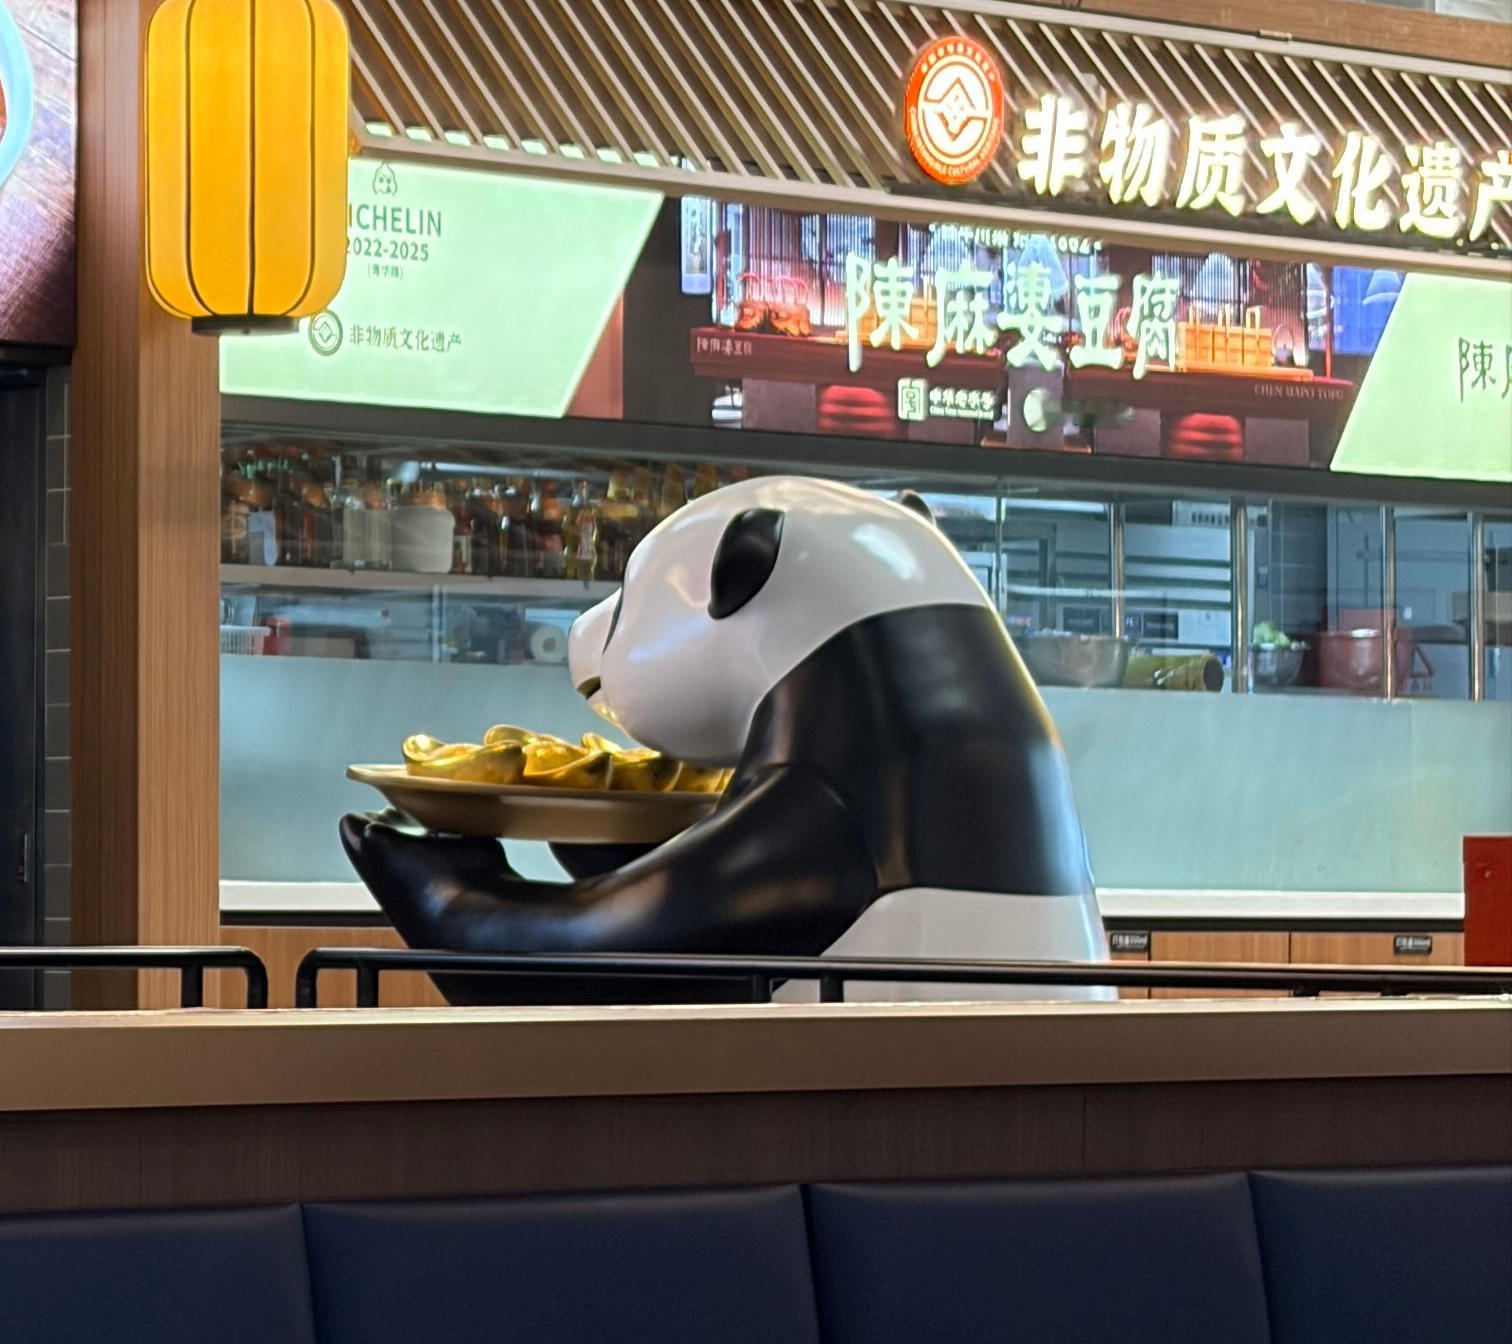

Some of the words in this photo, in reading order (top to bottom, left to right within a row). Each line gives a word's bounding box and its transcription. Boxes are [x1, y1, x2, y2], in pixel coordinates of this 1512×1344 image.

[1018, 93, 1512, 249] 非物质文化遗产
[347, 203, 442, 238] ICHELIN
[350, 324, 462, 353] 非物质文化遗产
[846, 253, 1179, 379] 陳麻婆豆腐
[1458, 337, 1512, 403] 陳
